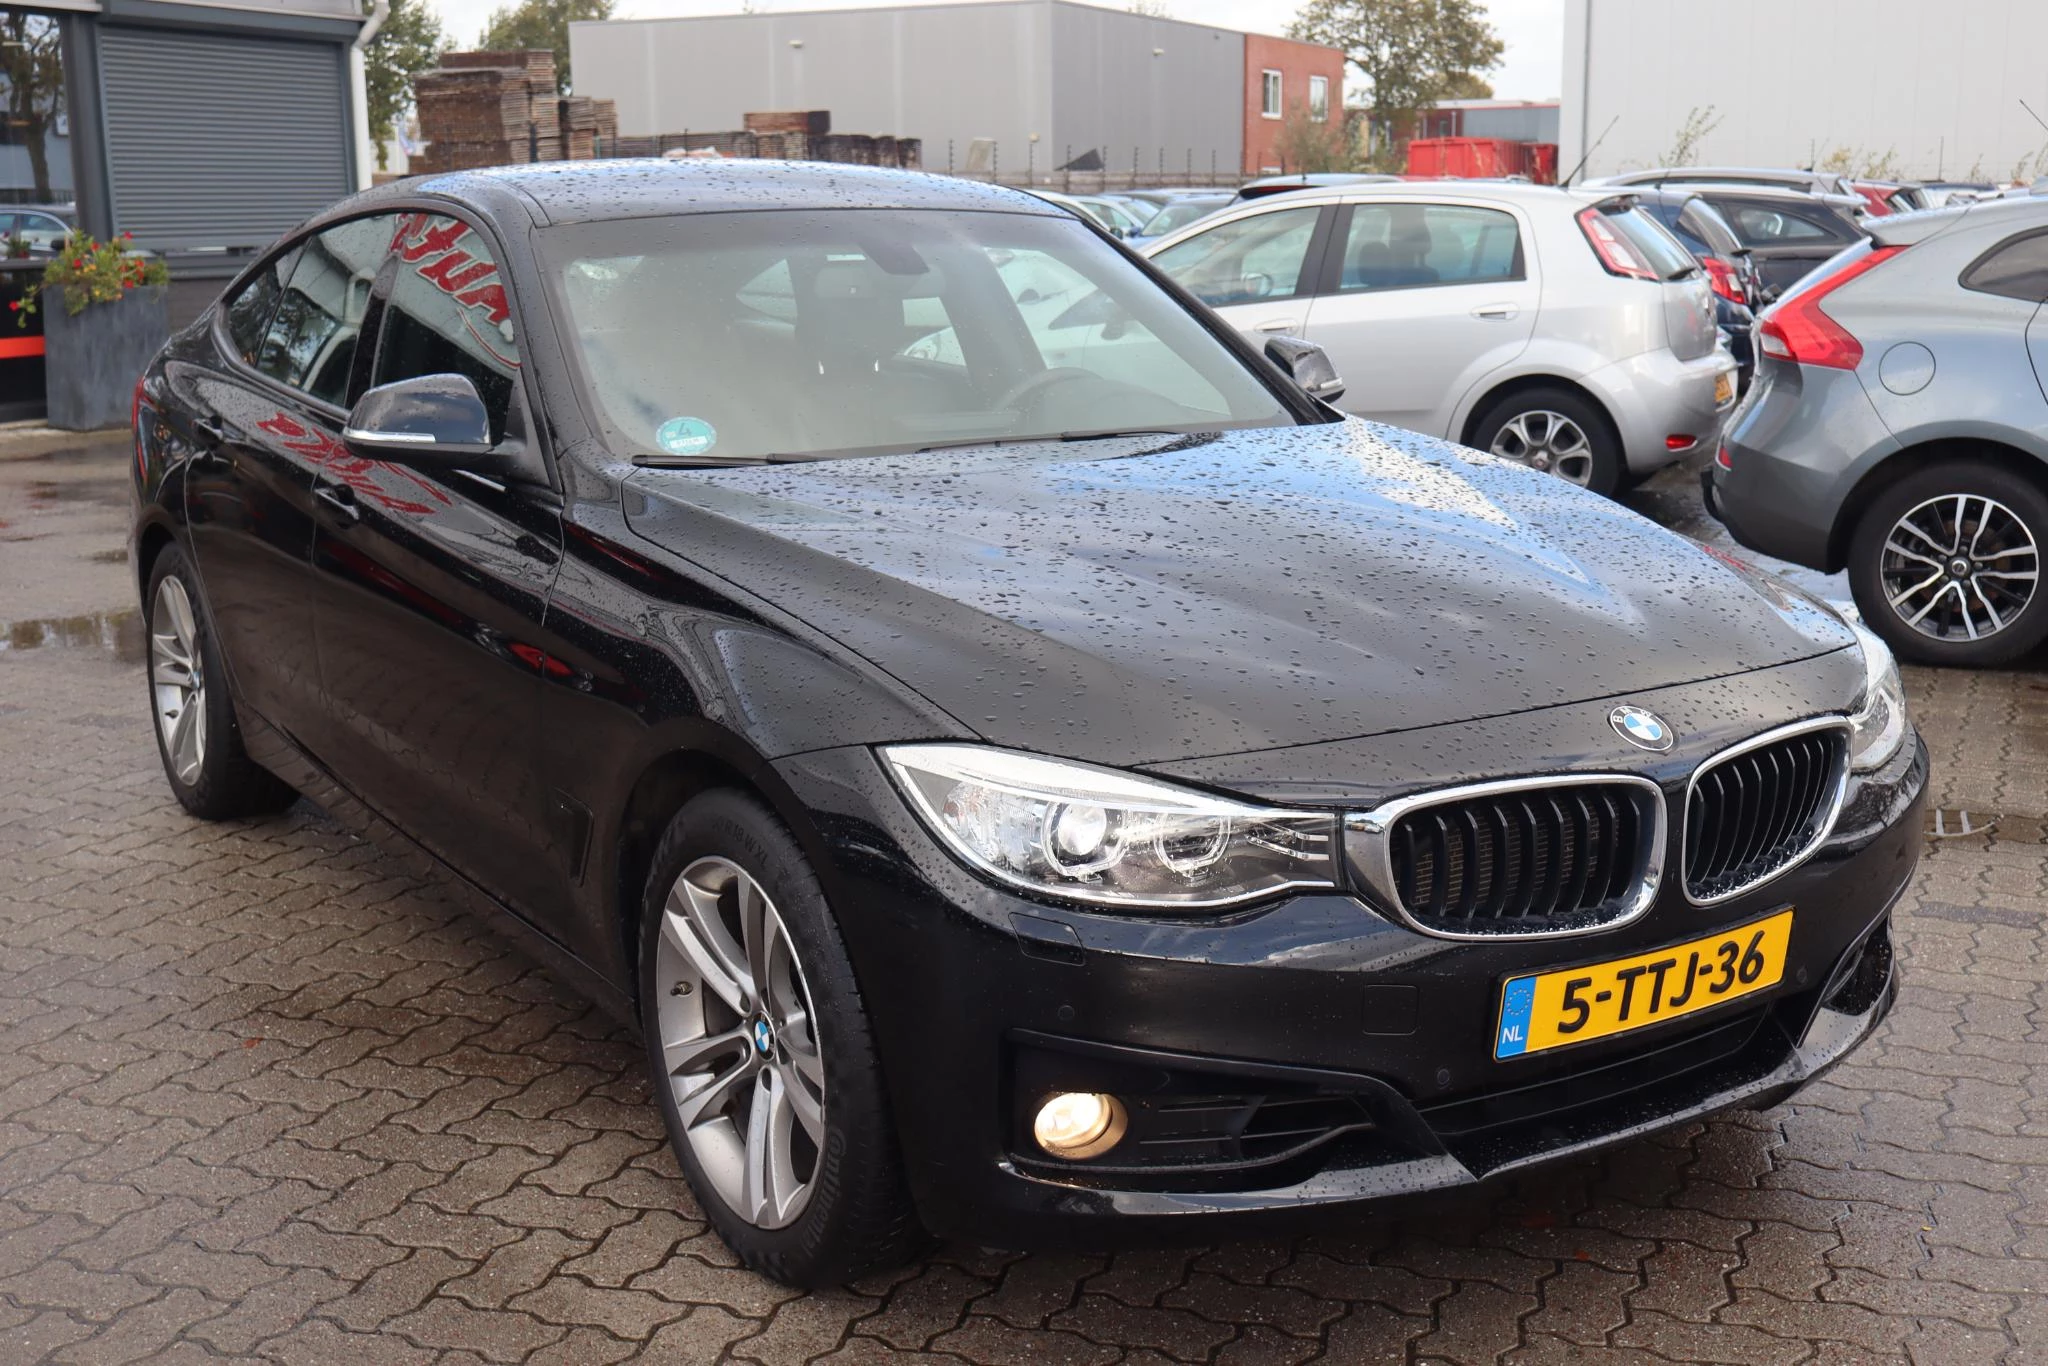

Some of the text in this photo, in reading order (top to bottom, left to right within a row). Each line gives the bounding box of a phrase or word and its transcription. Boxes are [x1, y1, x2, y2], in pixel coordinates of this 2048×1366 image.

[679, 423, 692, 436] 4
[1613, 706, 1652, 724] BMW
[1557, 930, 1766, 1034] 5-TTJ-36
[1502, 1025, 1524, 1045] NL
[801, 1125, 848, 1258] Continental
